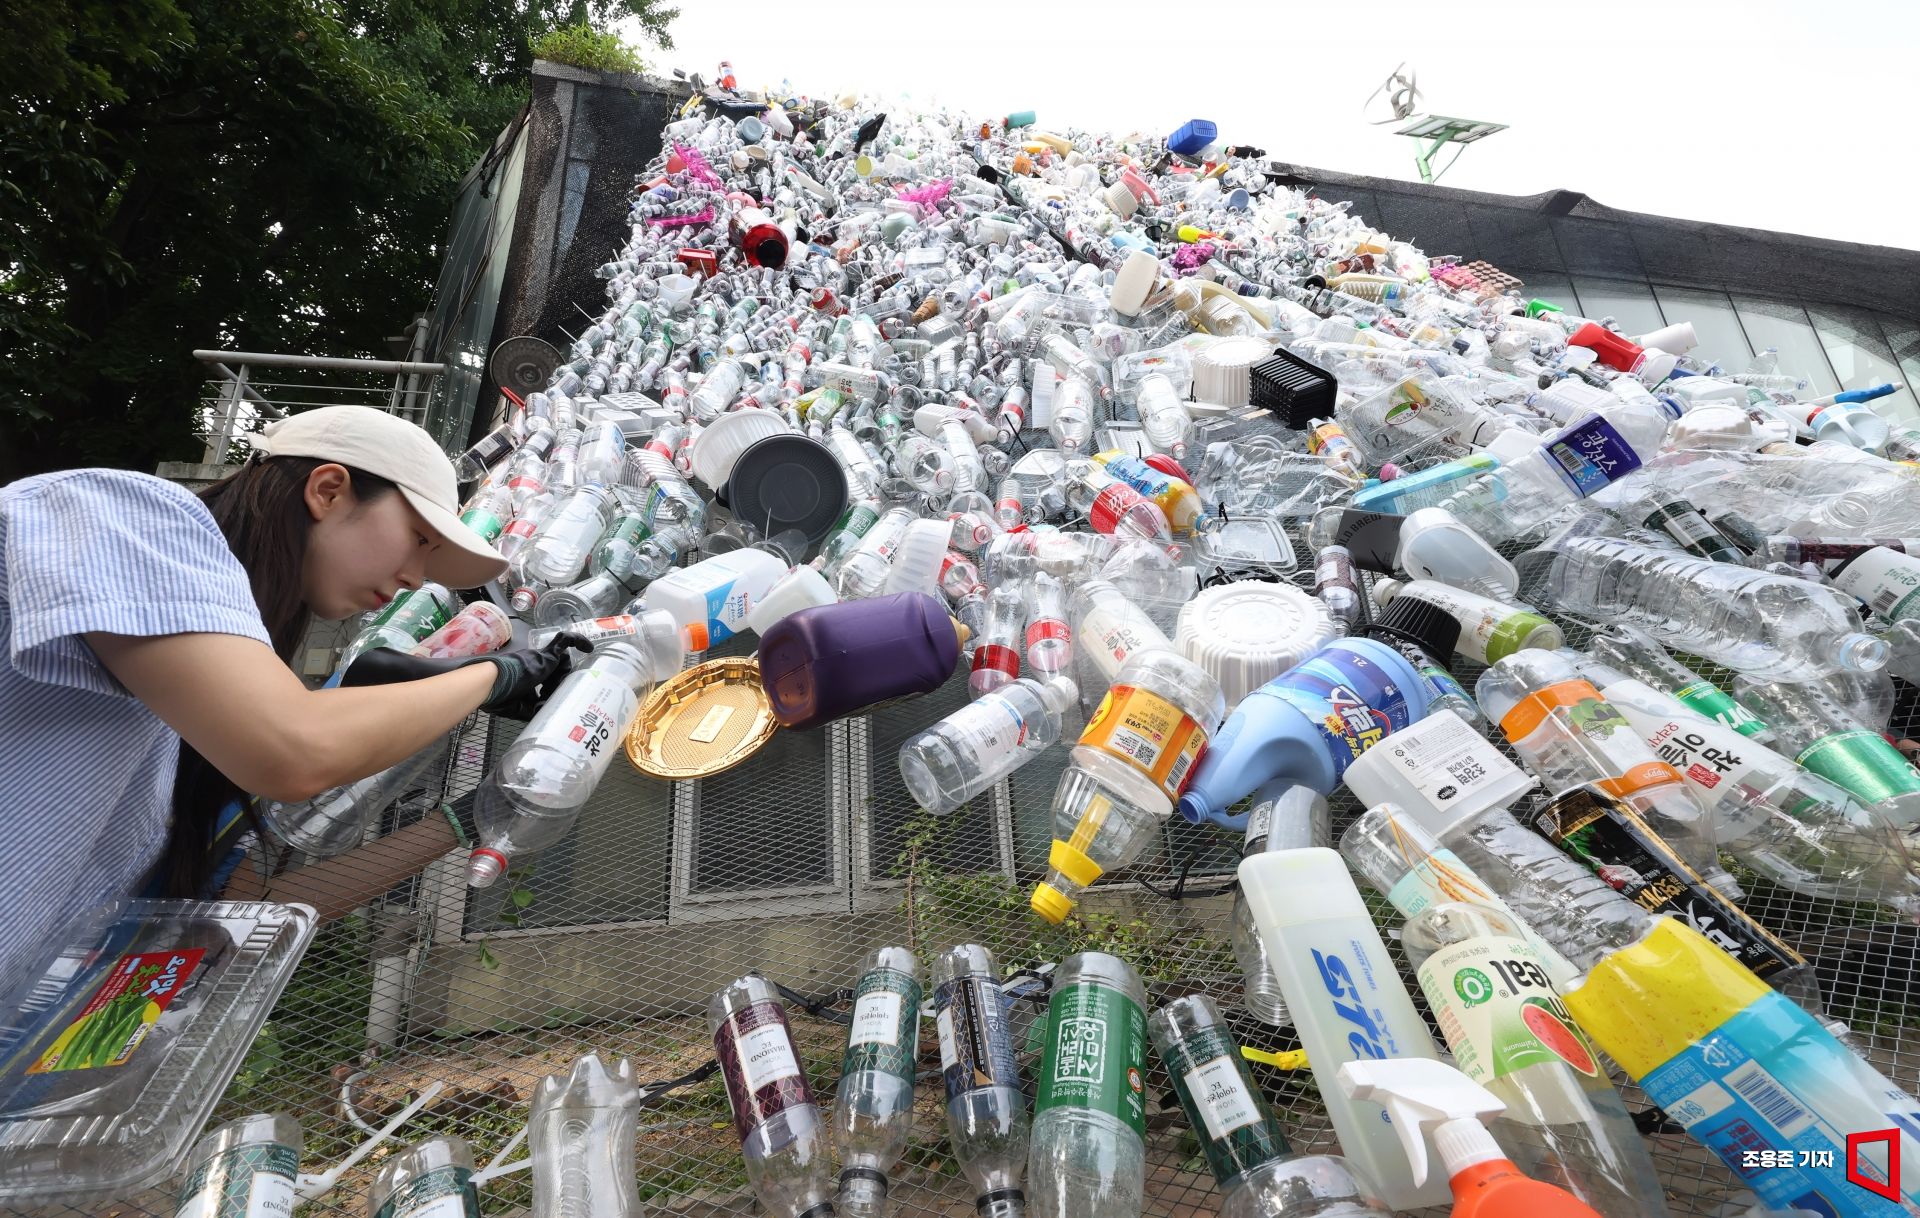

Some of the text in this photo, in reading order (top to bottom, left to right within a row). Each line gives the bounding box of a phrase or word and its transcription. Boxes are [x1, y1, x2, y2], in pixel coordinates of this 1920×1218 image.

[1353, 657, 1368, 668] 2L
[1324, 716, 1344, 733] NEW
[1657, 732, 1743, 774] 참이슬
[1453, 763, 1487, 786] 초강력
[140, 955, 186, 997] 오이맛
[1373, 1008, 1399, 1055] SYN
[750, 1045, 785, 1063] DIAMOND
[1503, 1040, 1539, 1055] Pulmuone
[1204, 1086, 1237, 1104] 다이아몬드
[1211, 1082, 1222, 1092] EC
[263, 1200, 292, 1216] AMOND
